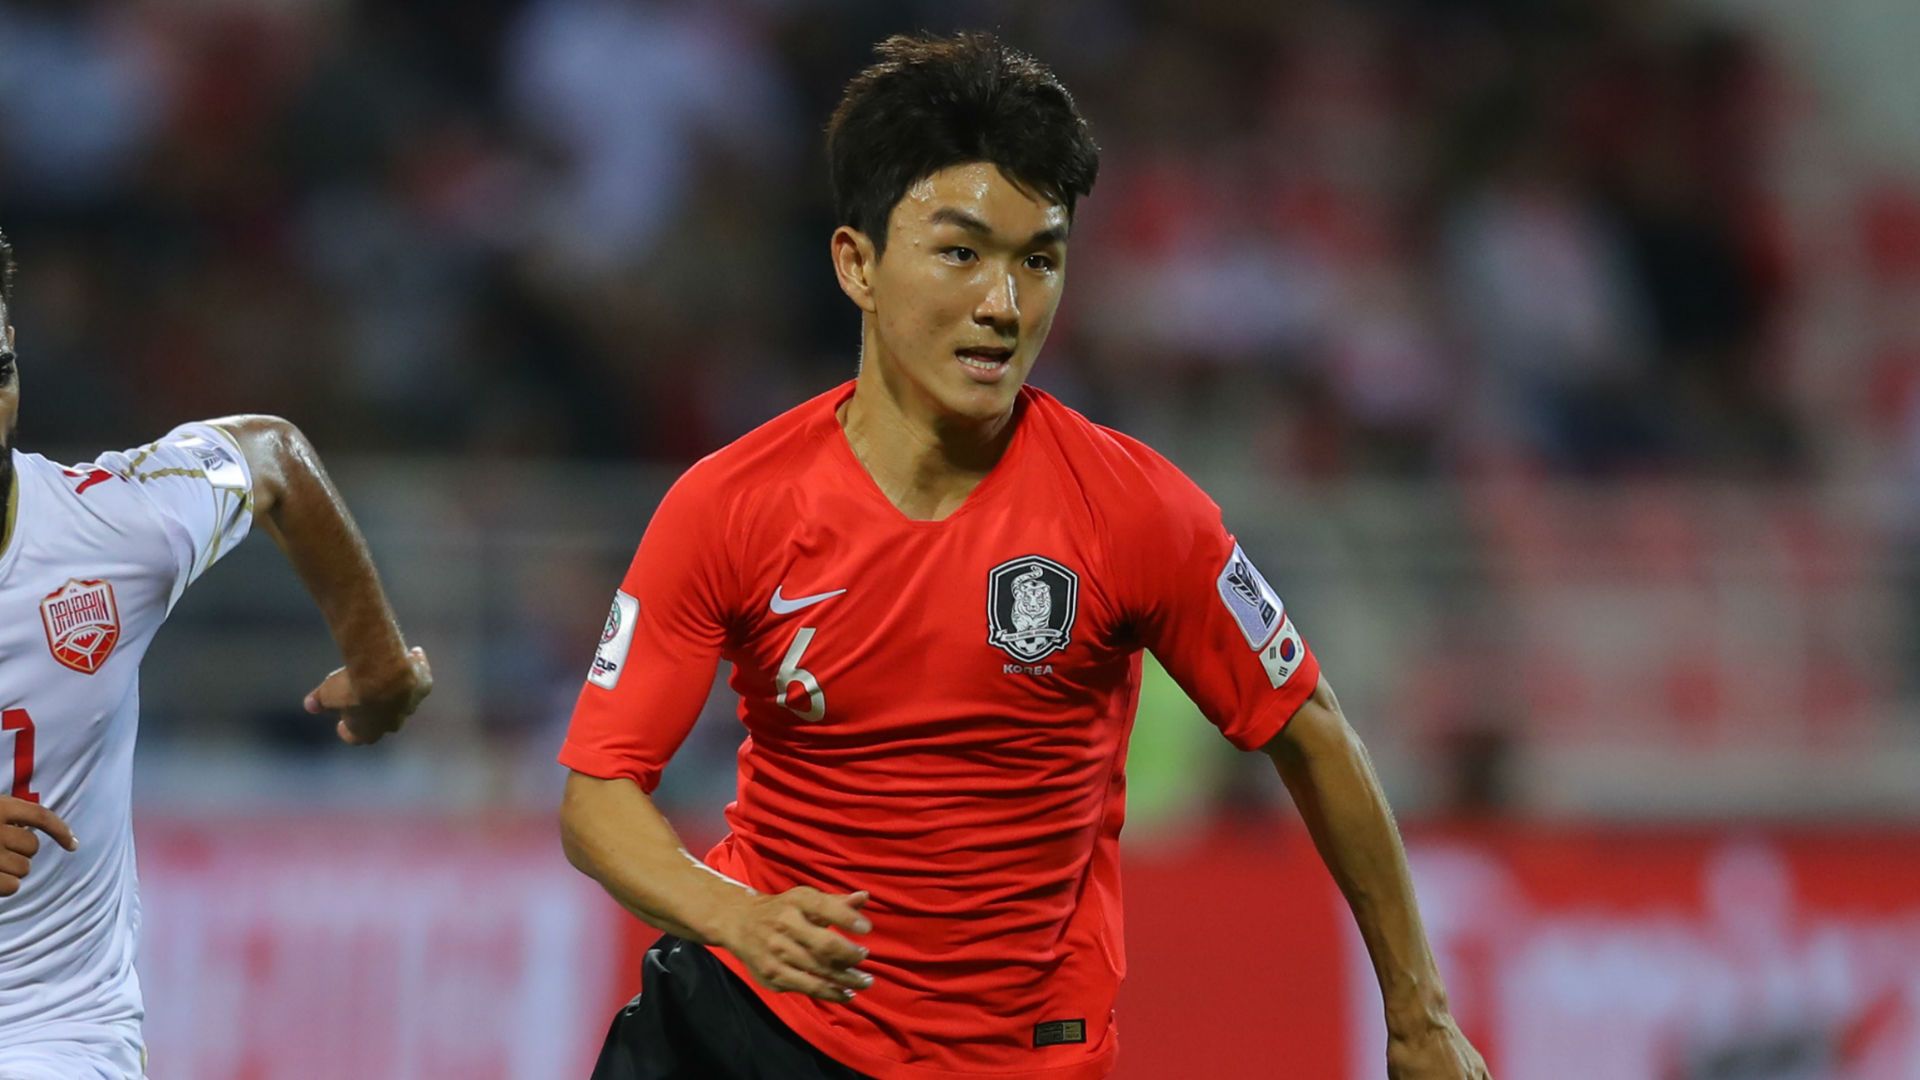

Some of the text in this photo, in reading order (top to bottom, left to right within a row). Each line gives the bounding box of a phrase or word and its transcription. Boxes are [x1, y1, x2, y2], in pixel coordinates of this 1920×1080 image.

[48, 589, 110, 637] BAHRAIN
[776, 627, 826, 721] 6
[1003, 663, 1053, 676] KOREA
